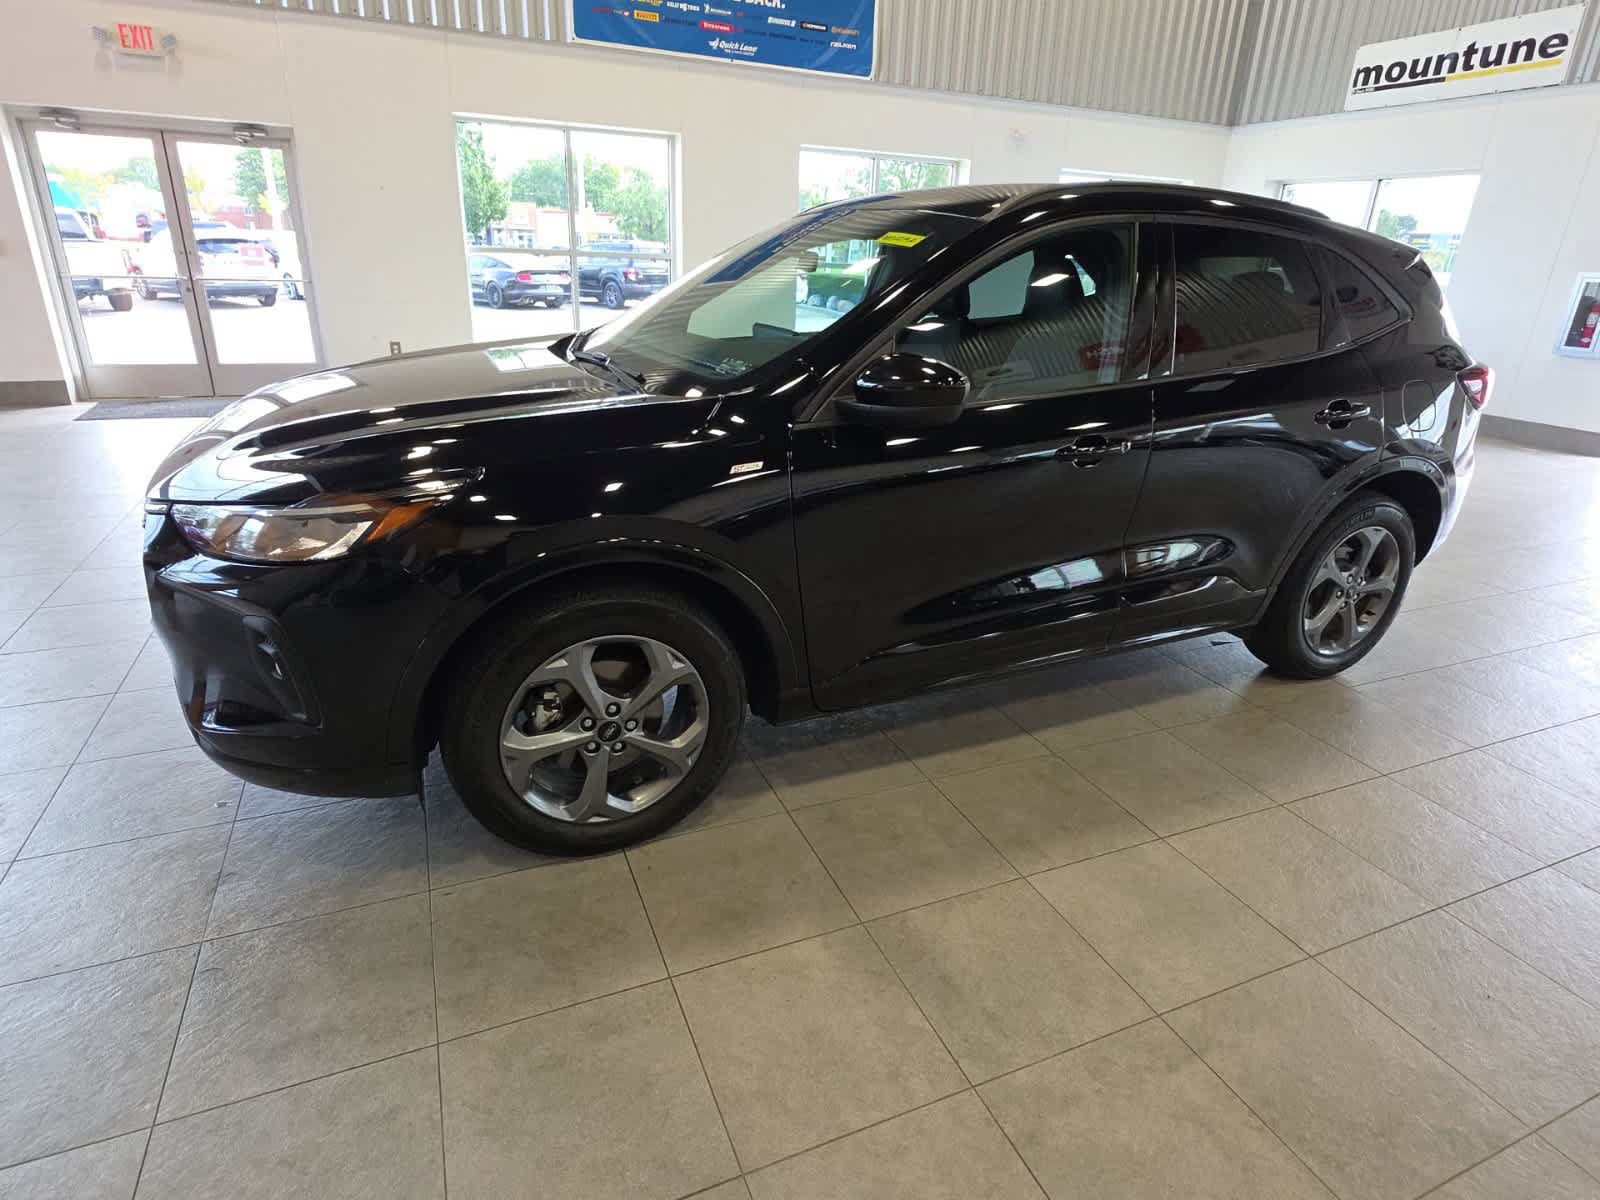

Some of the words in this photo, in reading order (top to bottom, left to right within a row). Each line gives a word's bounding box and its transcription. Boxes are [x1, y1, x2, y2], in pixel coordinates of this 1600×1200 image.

[745, 0, 786, 9] ACK.
[118, 24, 153, 50] EXIT
[719, 40, 740, 50] Quick
[740, 43, 758, 53] Lane
[1352, 32, 1569, 88] mountune
